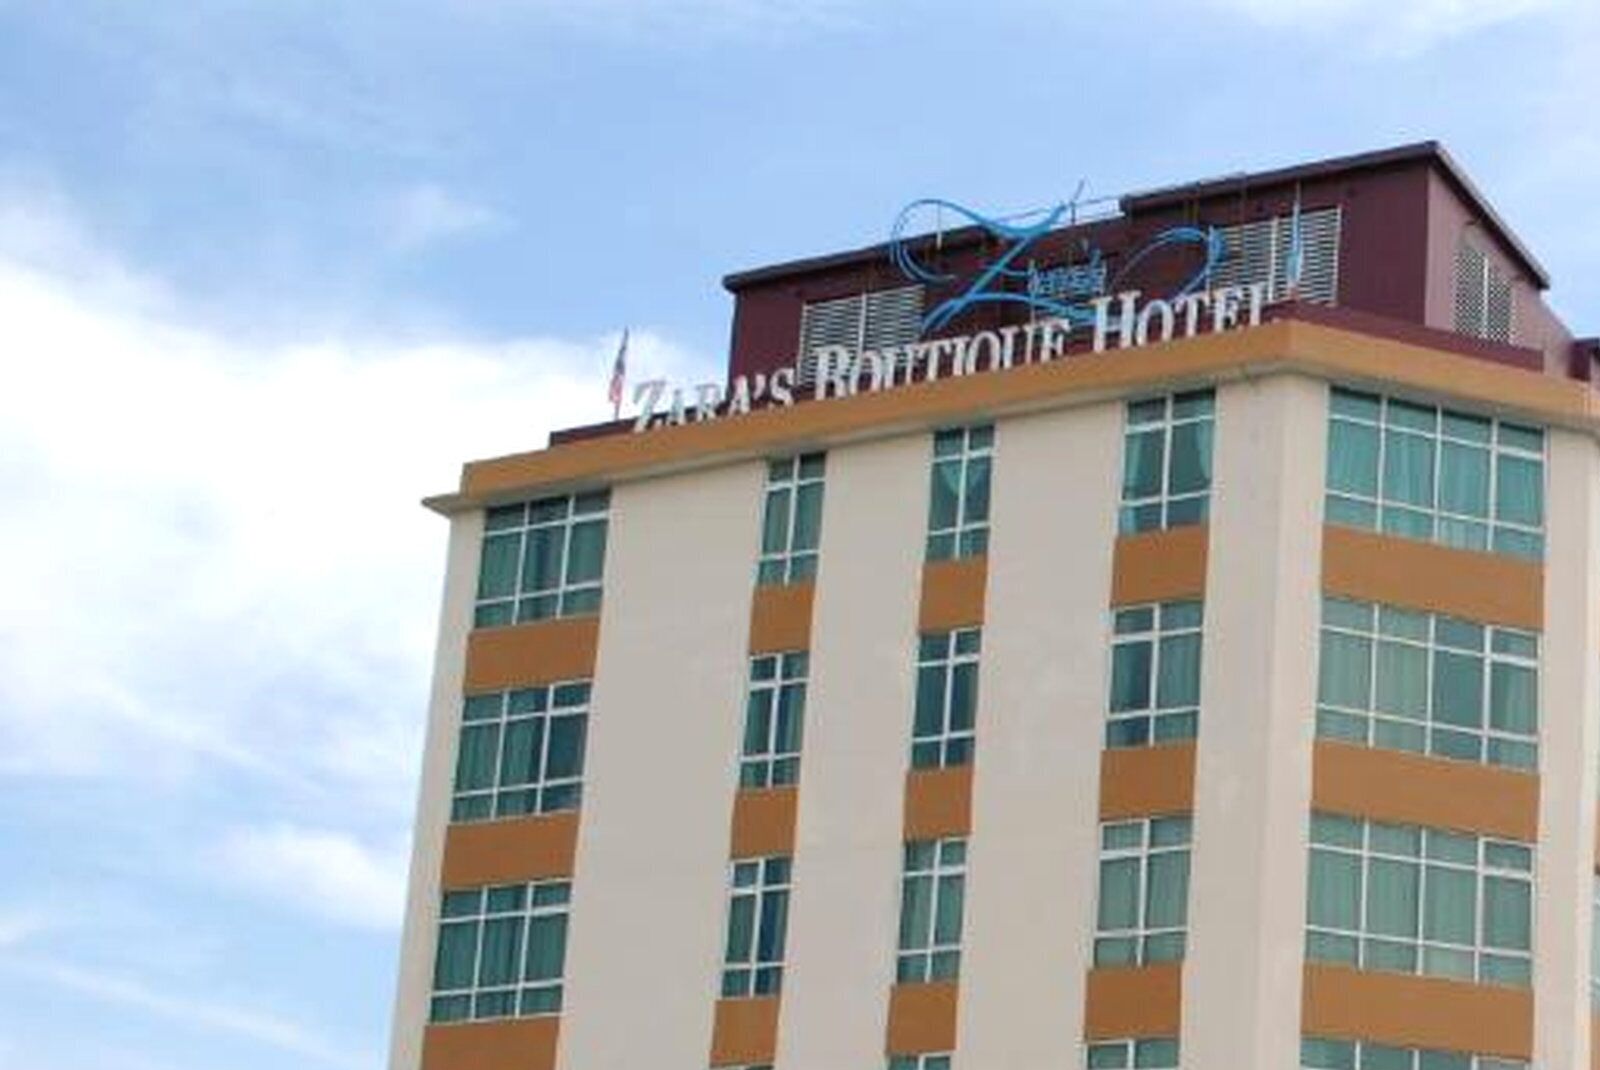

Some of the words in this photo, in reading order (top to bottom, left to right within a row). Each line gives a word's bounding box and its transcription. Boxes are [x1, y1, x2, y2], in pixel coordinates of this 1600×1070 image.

[632, 367, 796, 433] ZARA'S
[813, 317, 1072, 400] BOUTIQUE
[1092, 282, 1278, 353] HOTEL
